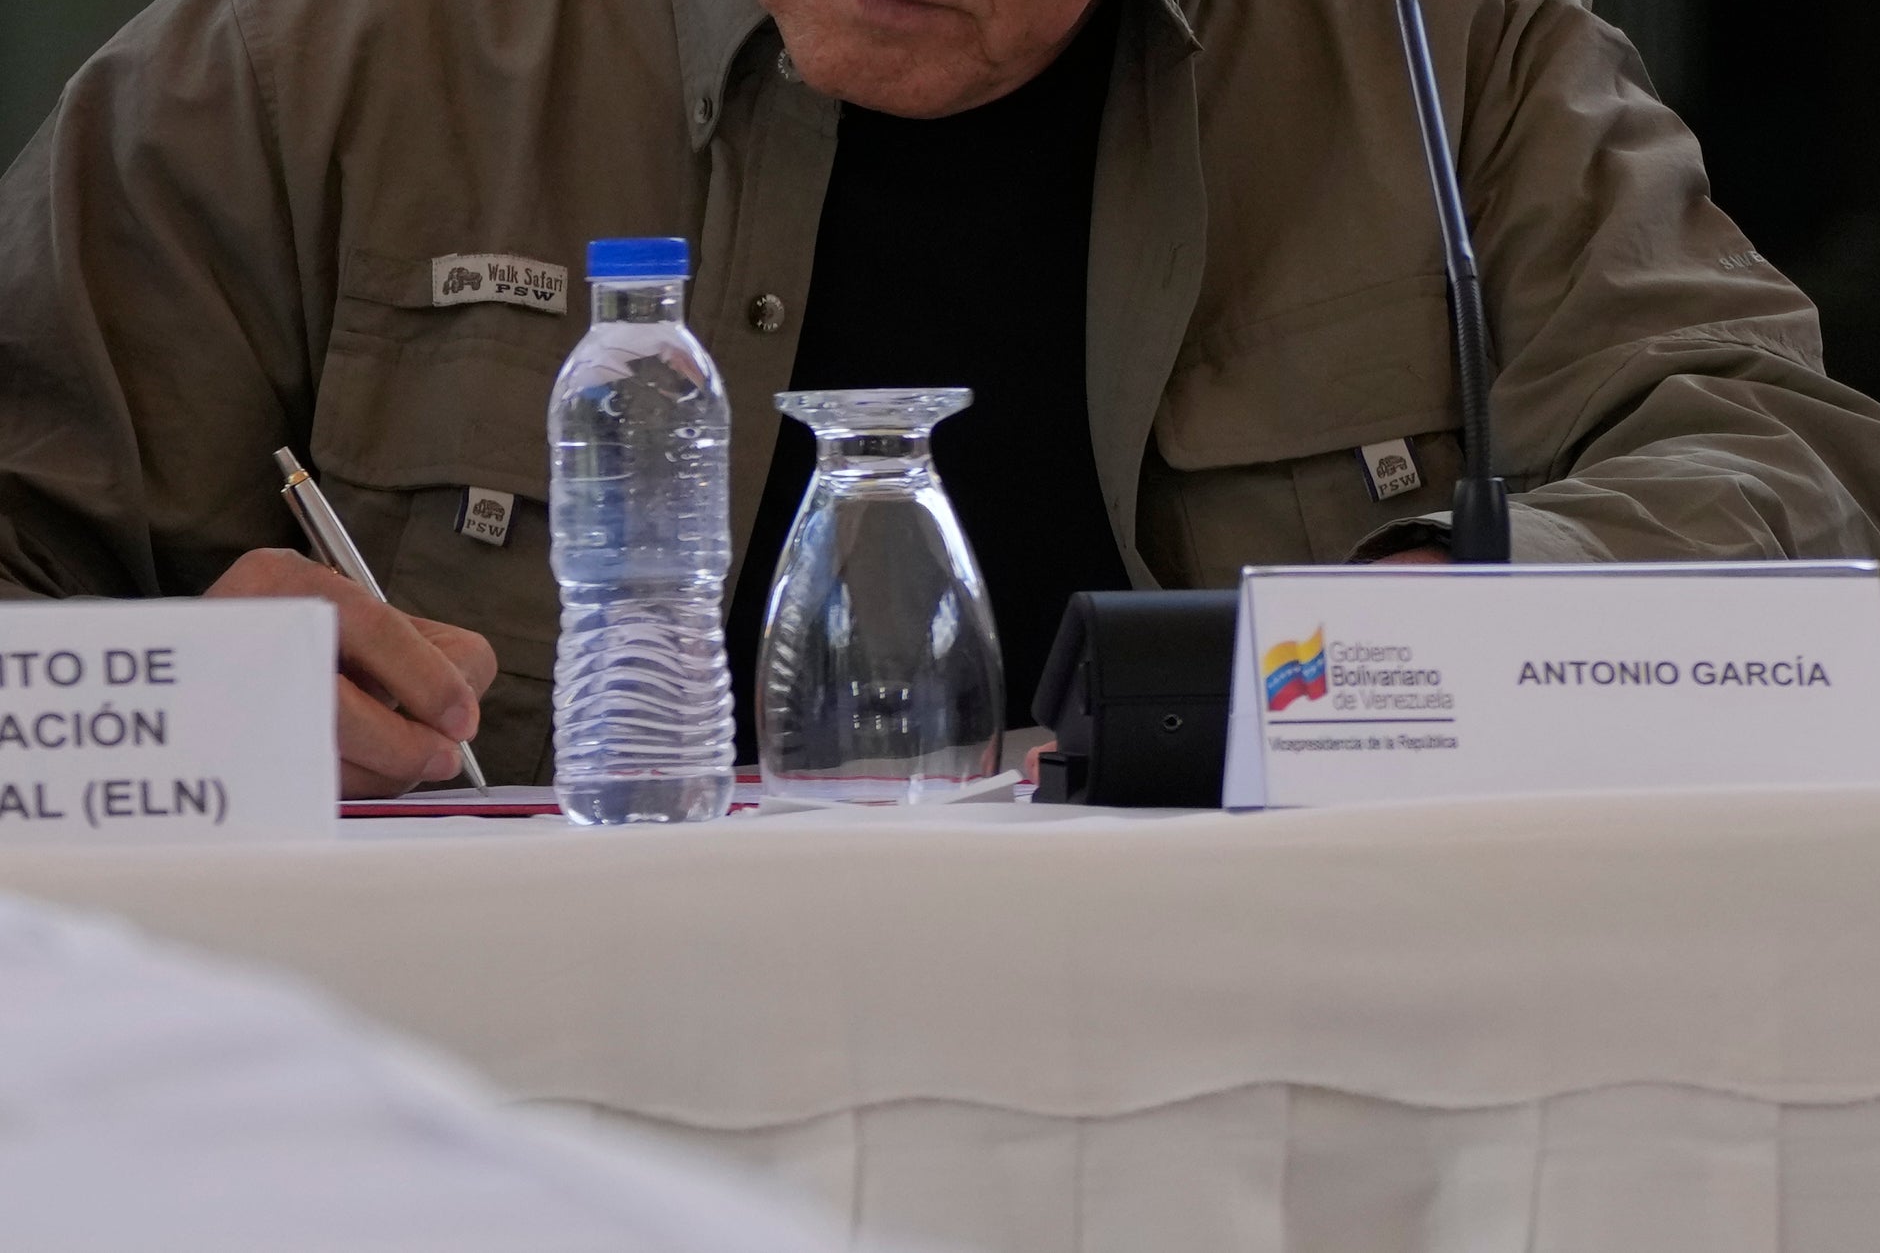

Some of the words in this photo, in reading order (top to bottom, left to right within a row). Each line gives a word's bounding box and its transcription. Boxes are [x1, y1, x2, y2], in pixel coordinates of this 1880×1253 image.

[487, 262, 519, 284] Walk
[524, 267, 563, 292] Safari
[495, 283, 555, 301] PSW
[1379, 472, 1417, 496] PSW
[465, 518, 506, 538] PSW
[103, 648, 175, 686] DE
[1332, 665, 1441, 687] Bolivariano
[1517, 660, 1680, 687] ANTONIO
[1692, 654, 1832, 687] GARCÍA
[1333, 690, 1357, 711] de
[1360, 689, 1454, 711] Venezuela
[83, 778, 228, 827] (ELN)
